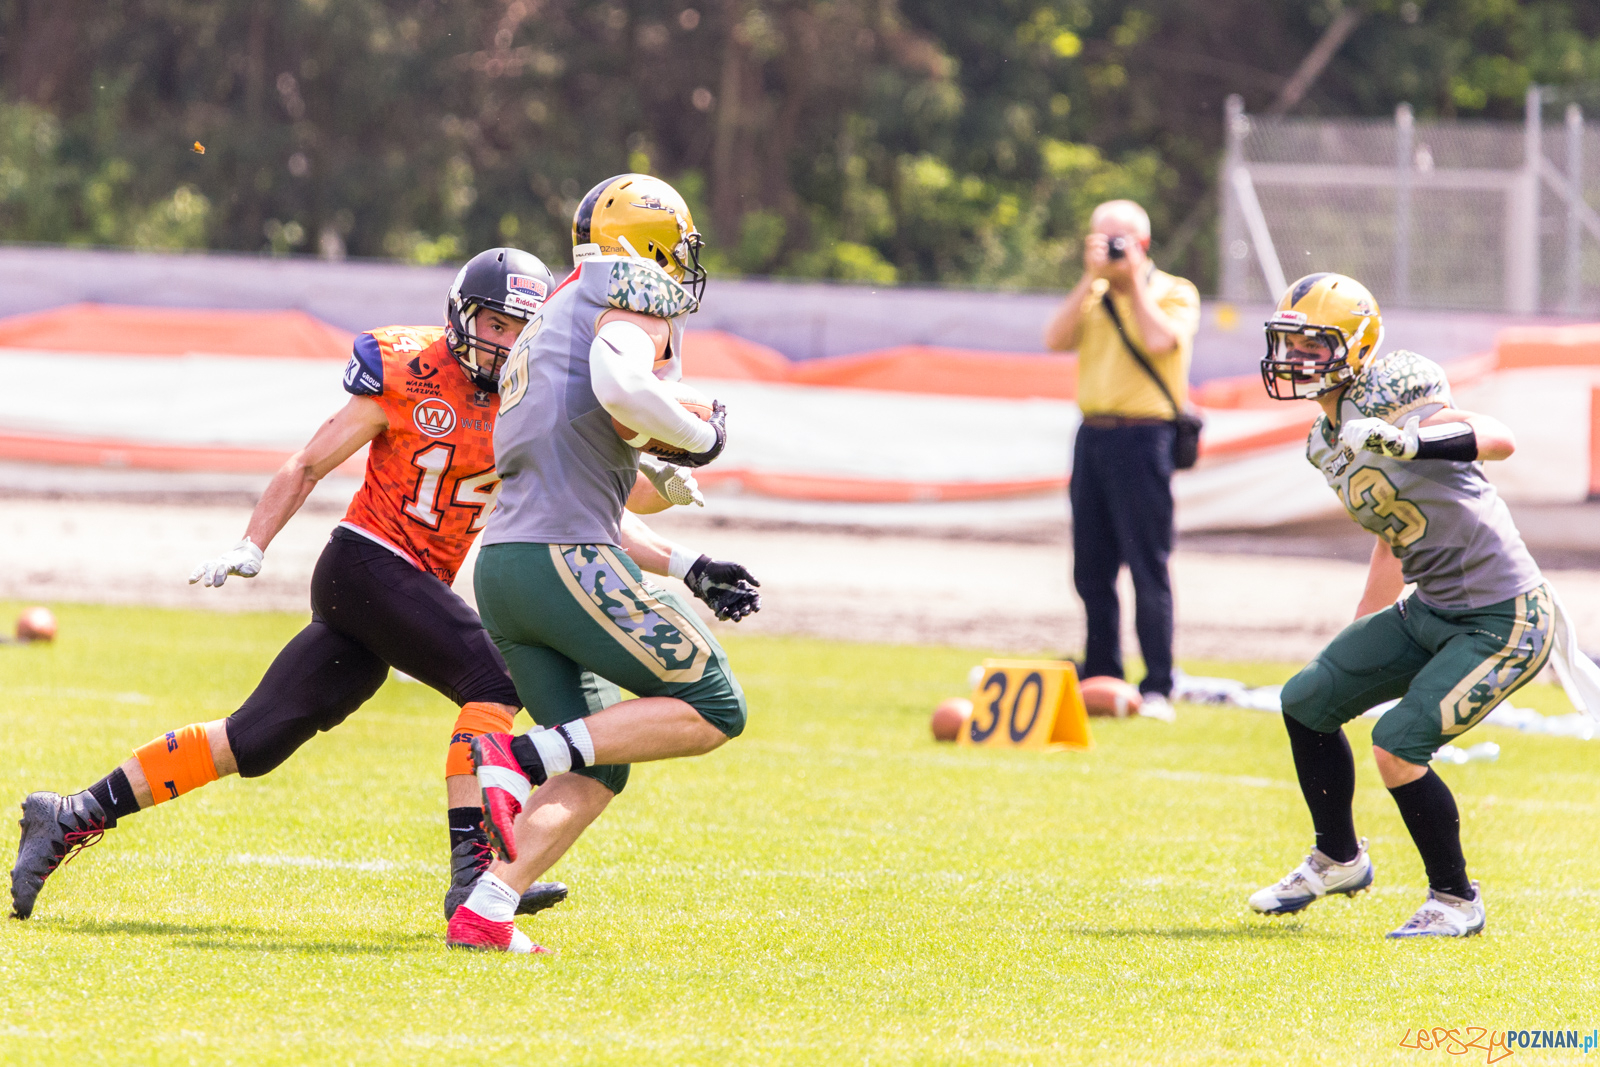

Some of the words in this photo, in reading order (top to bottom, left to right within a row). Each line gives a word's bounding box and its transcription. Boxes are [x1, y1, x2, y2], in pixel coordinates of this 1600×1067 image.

[510, 276, 546, 297] LAKERS
[515, 296, 538, 308] Riddell
[361, 371, 381, 389] GROUP
[405, 380, 441, 390] WARMIA
[401, 440, 502, 534] 14
[1337, 465, 1429, 549] 3
[970, 671, 1043, 743] 30
